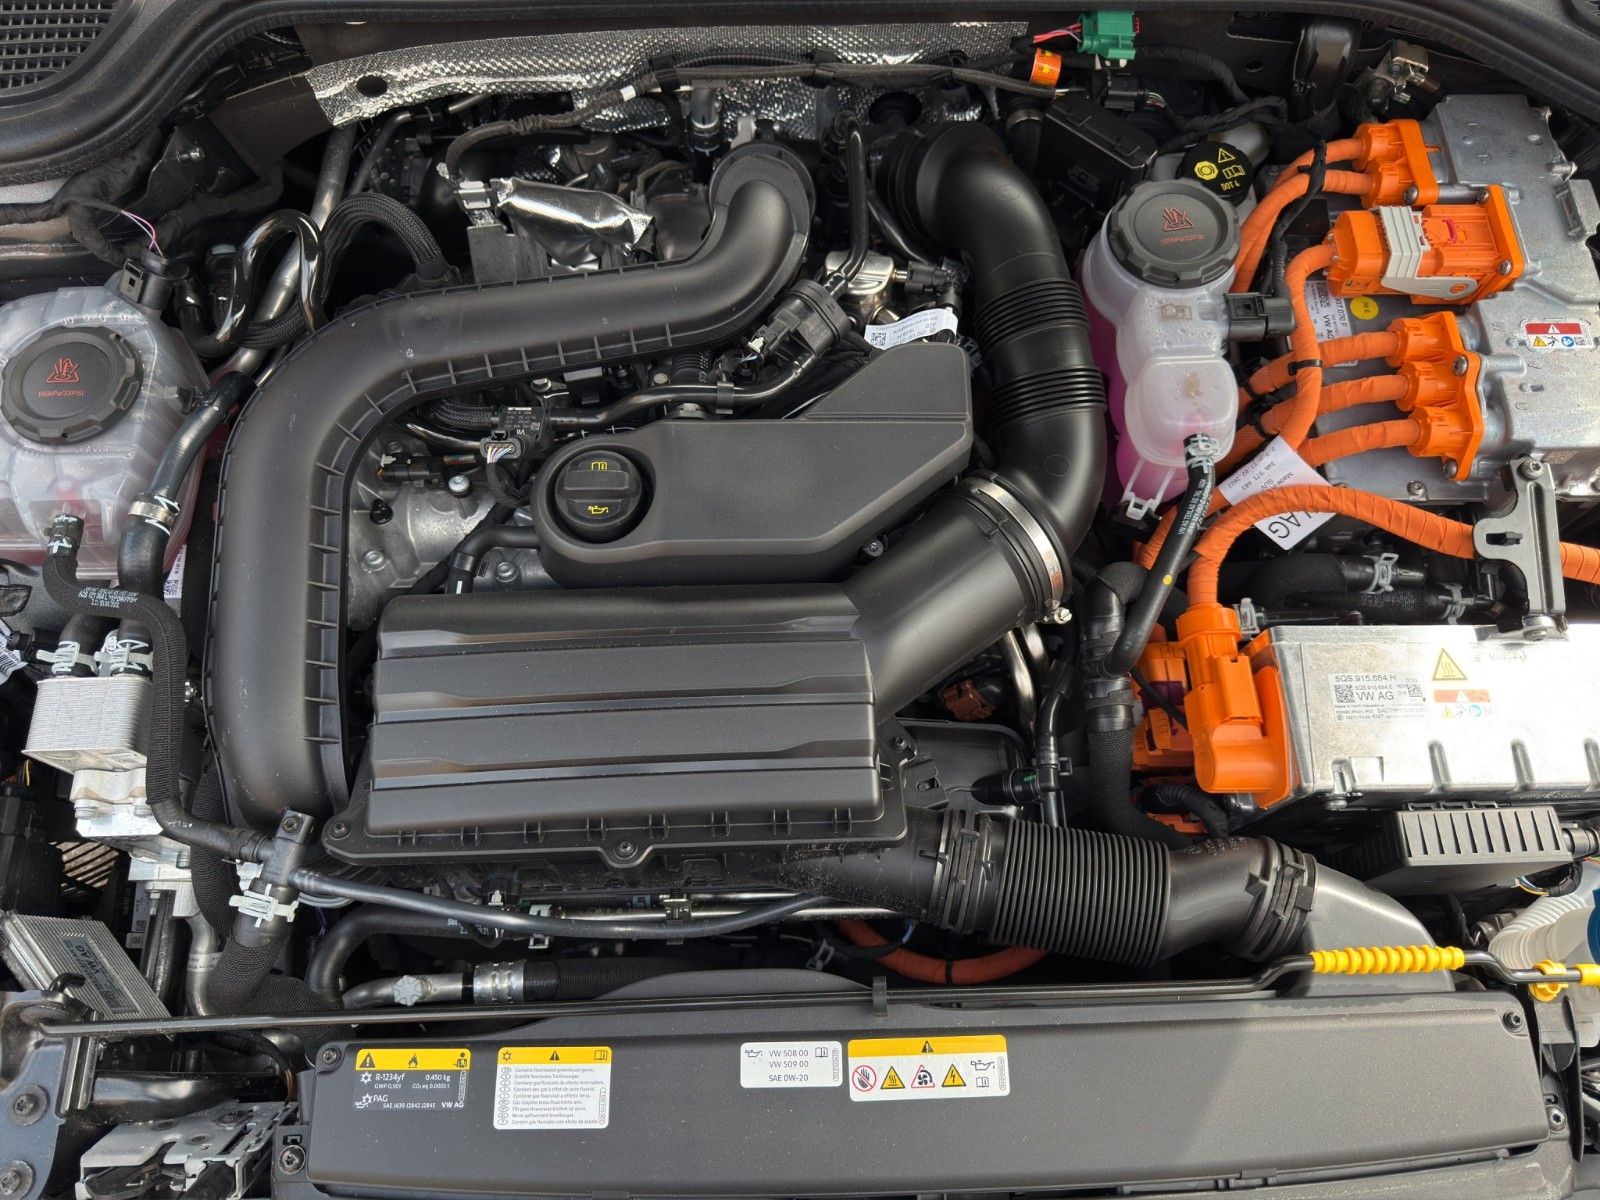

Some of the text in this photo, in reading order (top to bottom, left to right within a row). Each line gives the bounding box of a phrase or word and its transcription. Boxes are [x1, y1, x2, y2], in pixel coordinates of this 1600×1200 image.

[1220, 181, 1234, 190] DOT
[1323, 314, 1331, 329] VW
[1276, 472, 1294, 485] Made
[1268, 512, 1302, 539] AG
[1356, 691, 1374, 700] VW
[1378, 690, 1394, 700] AG
[375, 1073, 405, 1082] R-1234yf
[443, 1074, 451, 1082] kg
